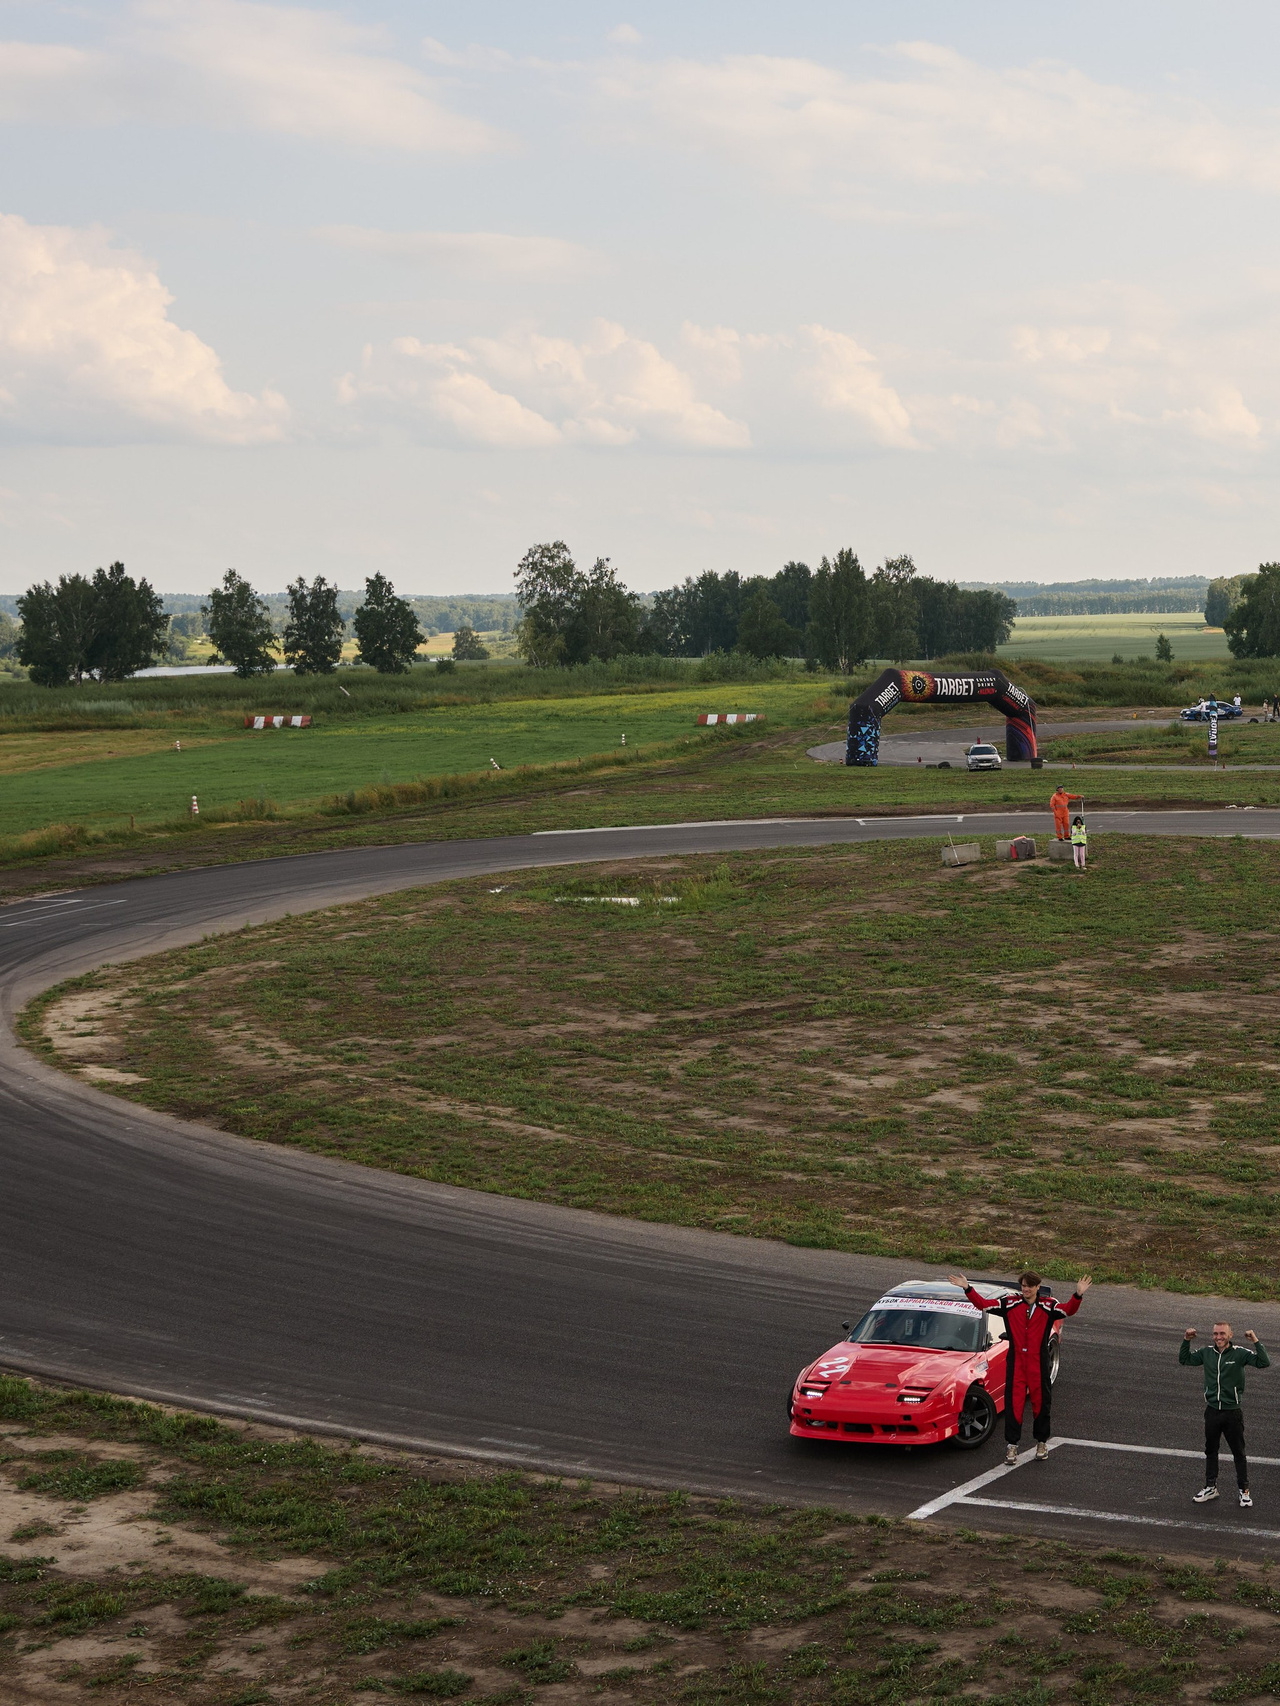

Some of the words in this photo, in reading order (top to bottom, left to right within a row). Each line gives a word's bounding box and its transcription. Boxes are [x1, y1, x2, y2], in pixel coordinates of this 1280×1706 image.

[874, 681, 901, 707] TARGET
[934, 677, 975, 696] TARGET
[1006, 682, 1029, 704] TARGET
[818, 1356, 850, 1378] 22
